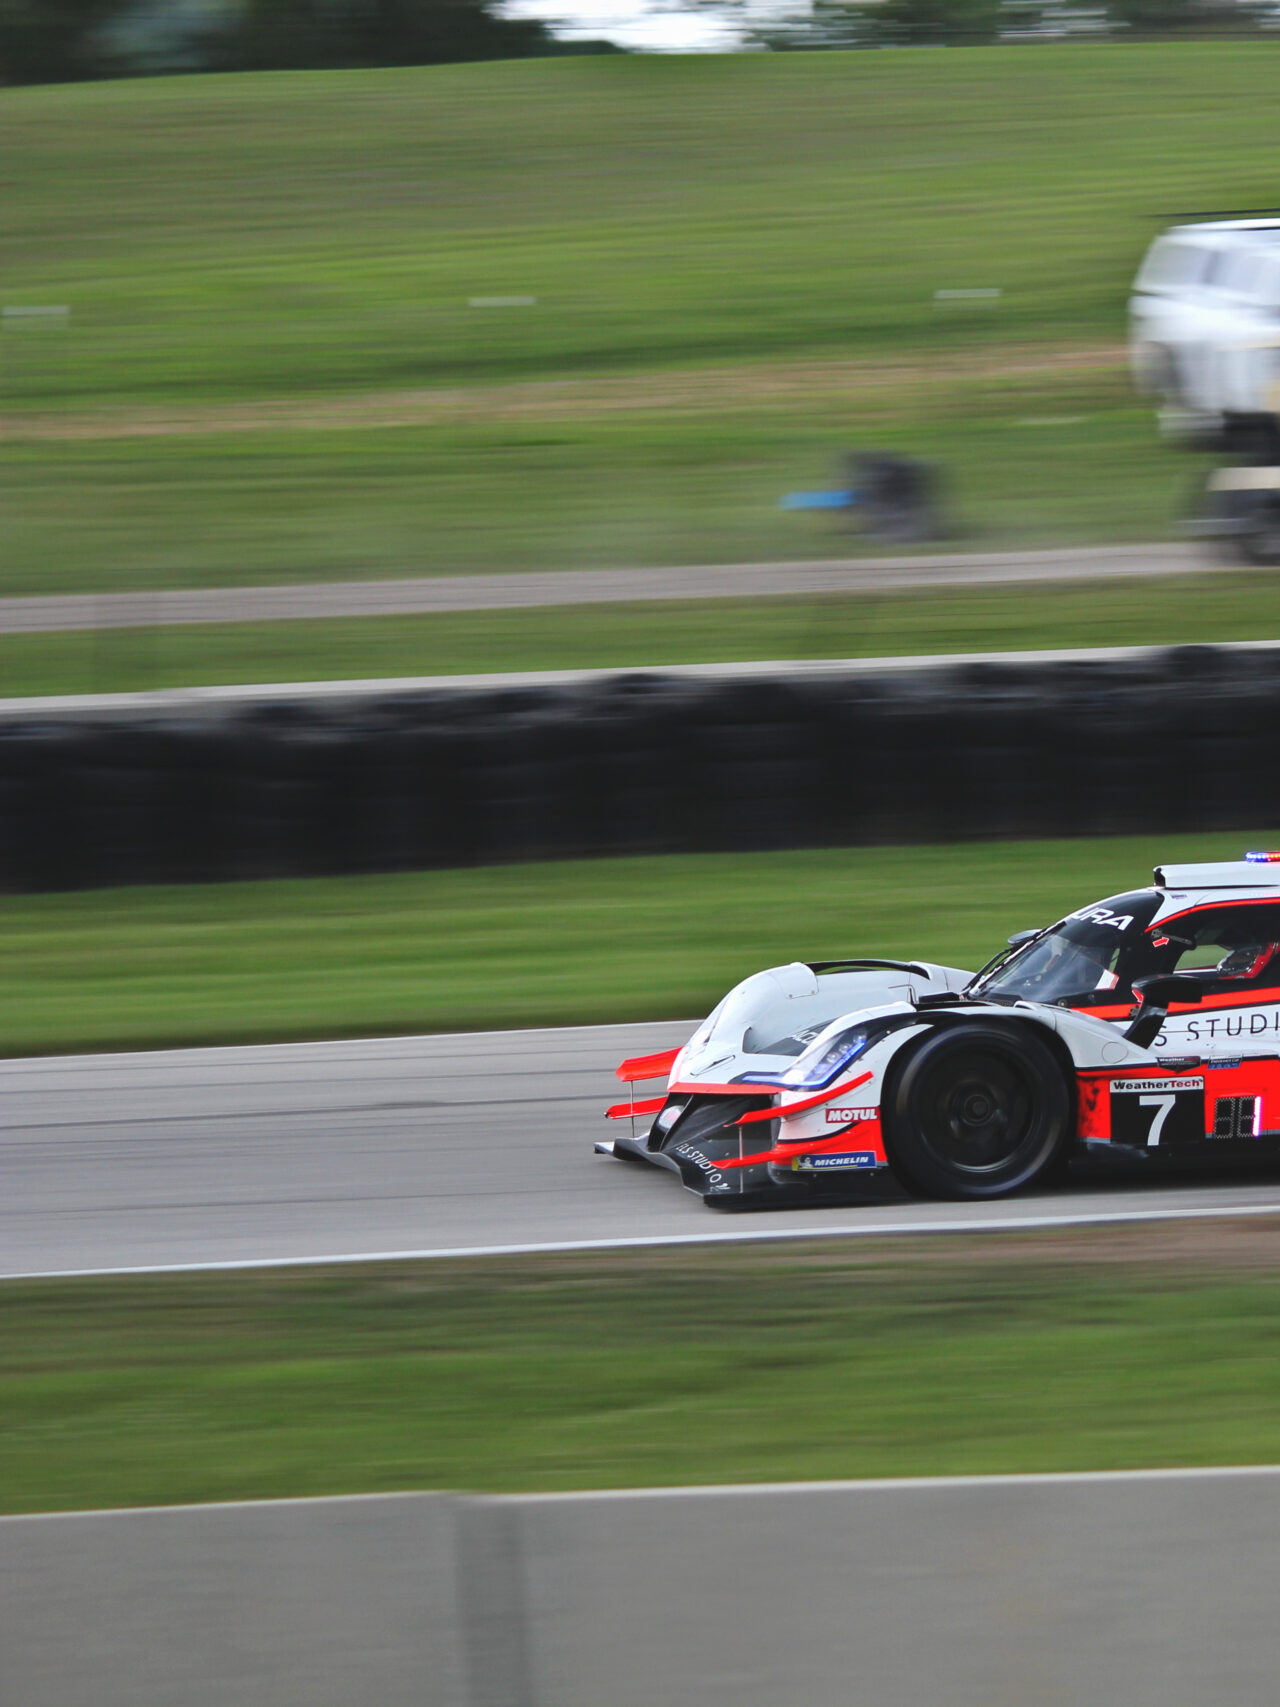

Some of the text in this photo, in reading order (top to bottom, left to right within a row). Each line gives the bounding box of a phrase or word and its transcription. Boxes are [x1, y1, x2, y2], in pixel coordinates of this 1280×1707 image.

[1113, 1079, 1200, 1091] WeatherTech
[828, 1108, 878, 1122] MOTUL
[1138, 1094, 1176, 1147] 7
[814, 1156, 869, 1167] MICHELIN
